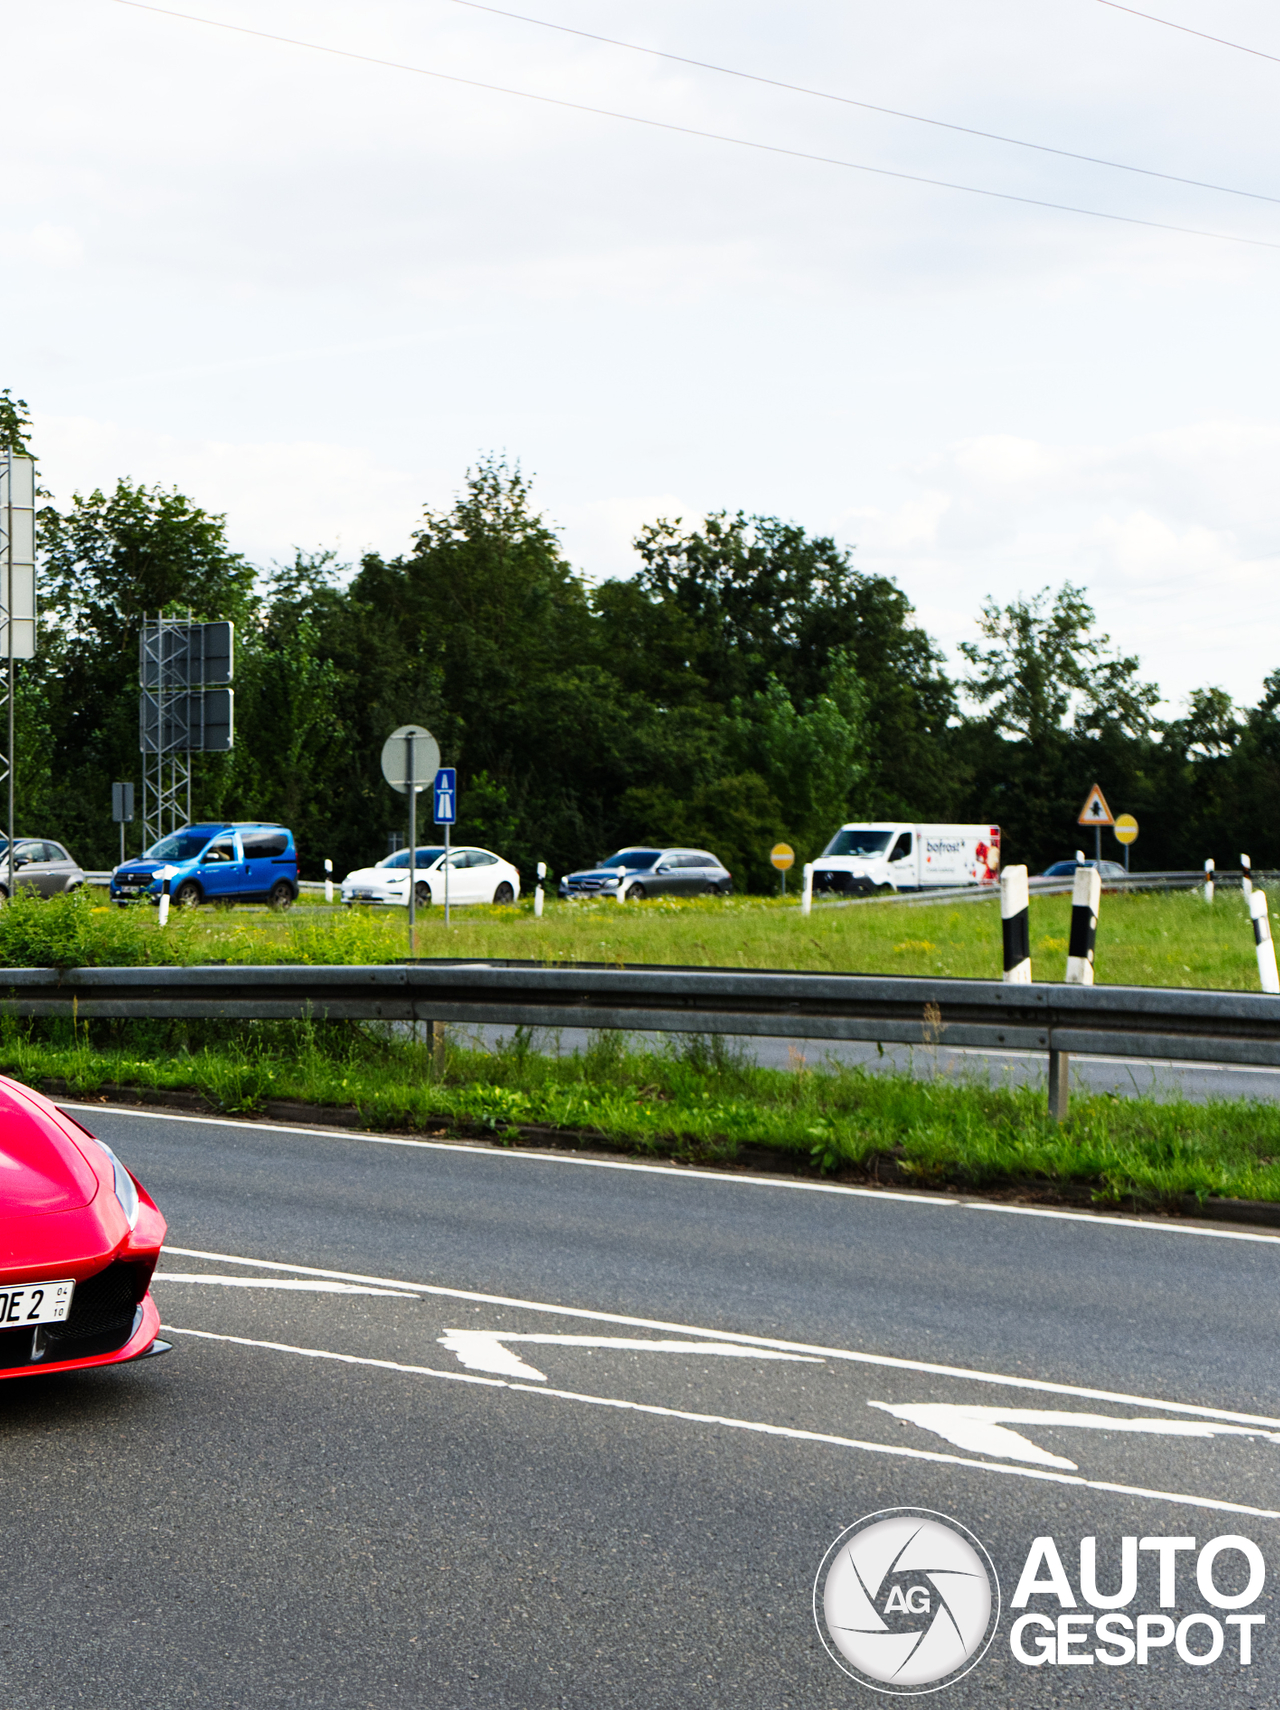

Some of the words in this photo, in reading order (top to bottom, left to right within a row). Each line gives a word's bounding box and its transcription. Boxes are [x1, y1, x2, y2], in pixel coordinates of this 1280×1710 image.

[56, 1287, 68, 1296] 04
[26, 1289, 44, 1320] 2
[53, 1307, 65, 1317] 10
